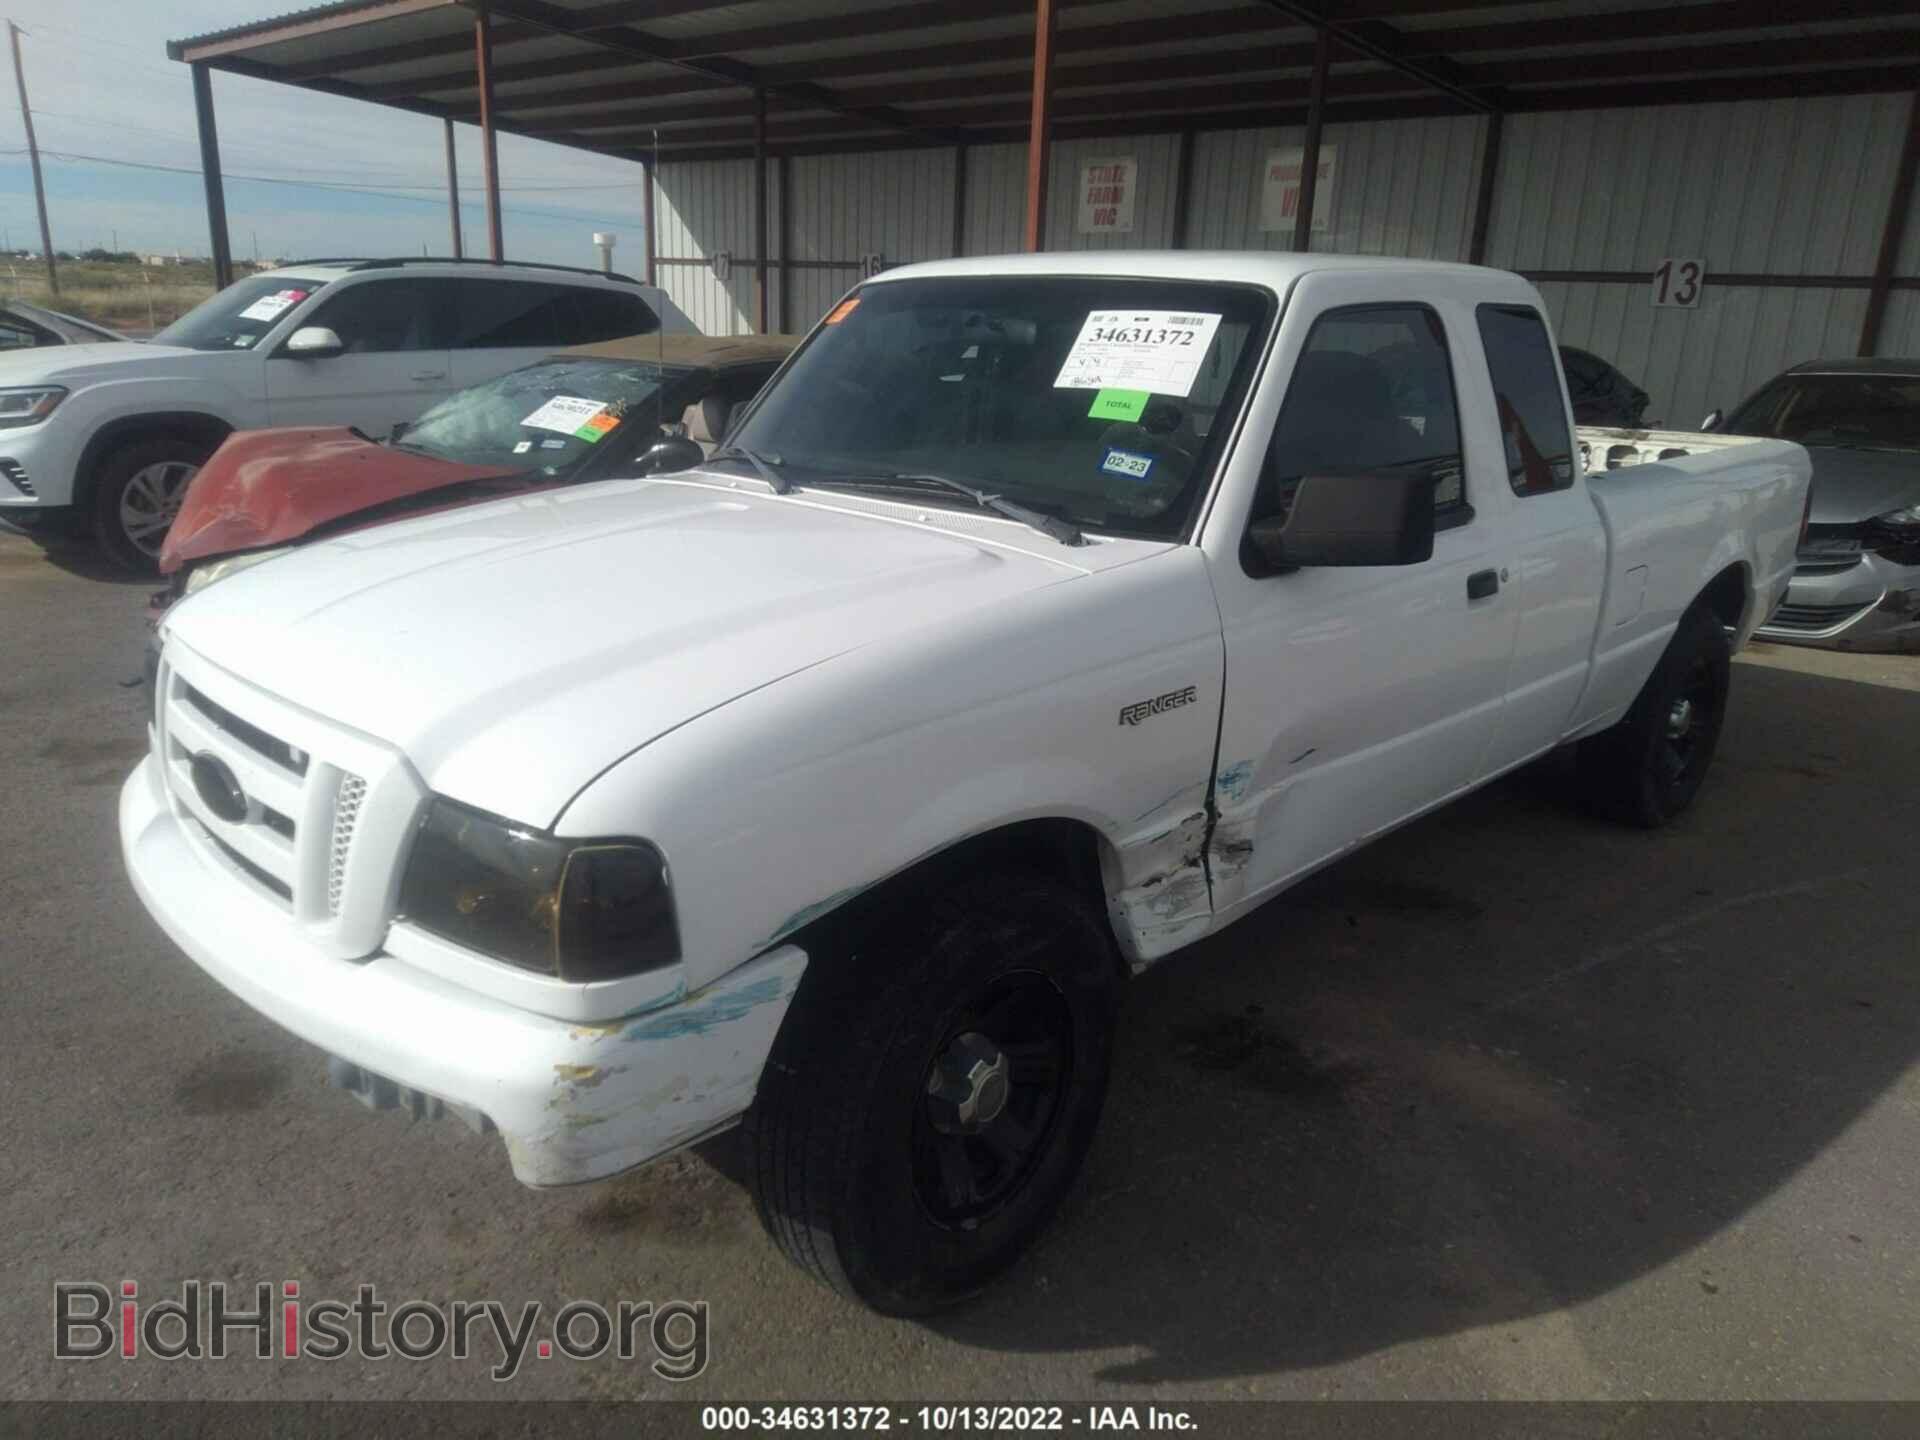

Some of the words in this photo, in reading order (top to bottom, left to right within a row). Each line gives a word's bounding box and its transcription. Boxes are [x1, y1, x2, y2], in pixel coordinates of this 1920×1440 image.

[861, 255, 880, 278] 16
[1656, 260, 1699, 305] 13
[1088, 327, 1195, 346] 34631372
[1105, 400, 1132, 409] TOTAL
